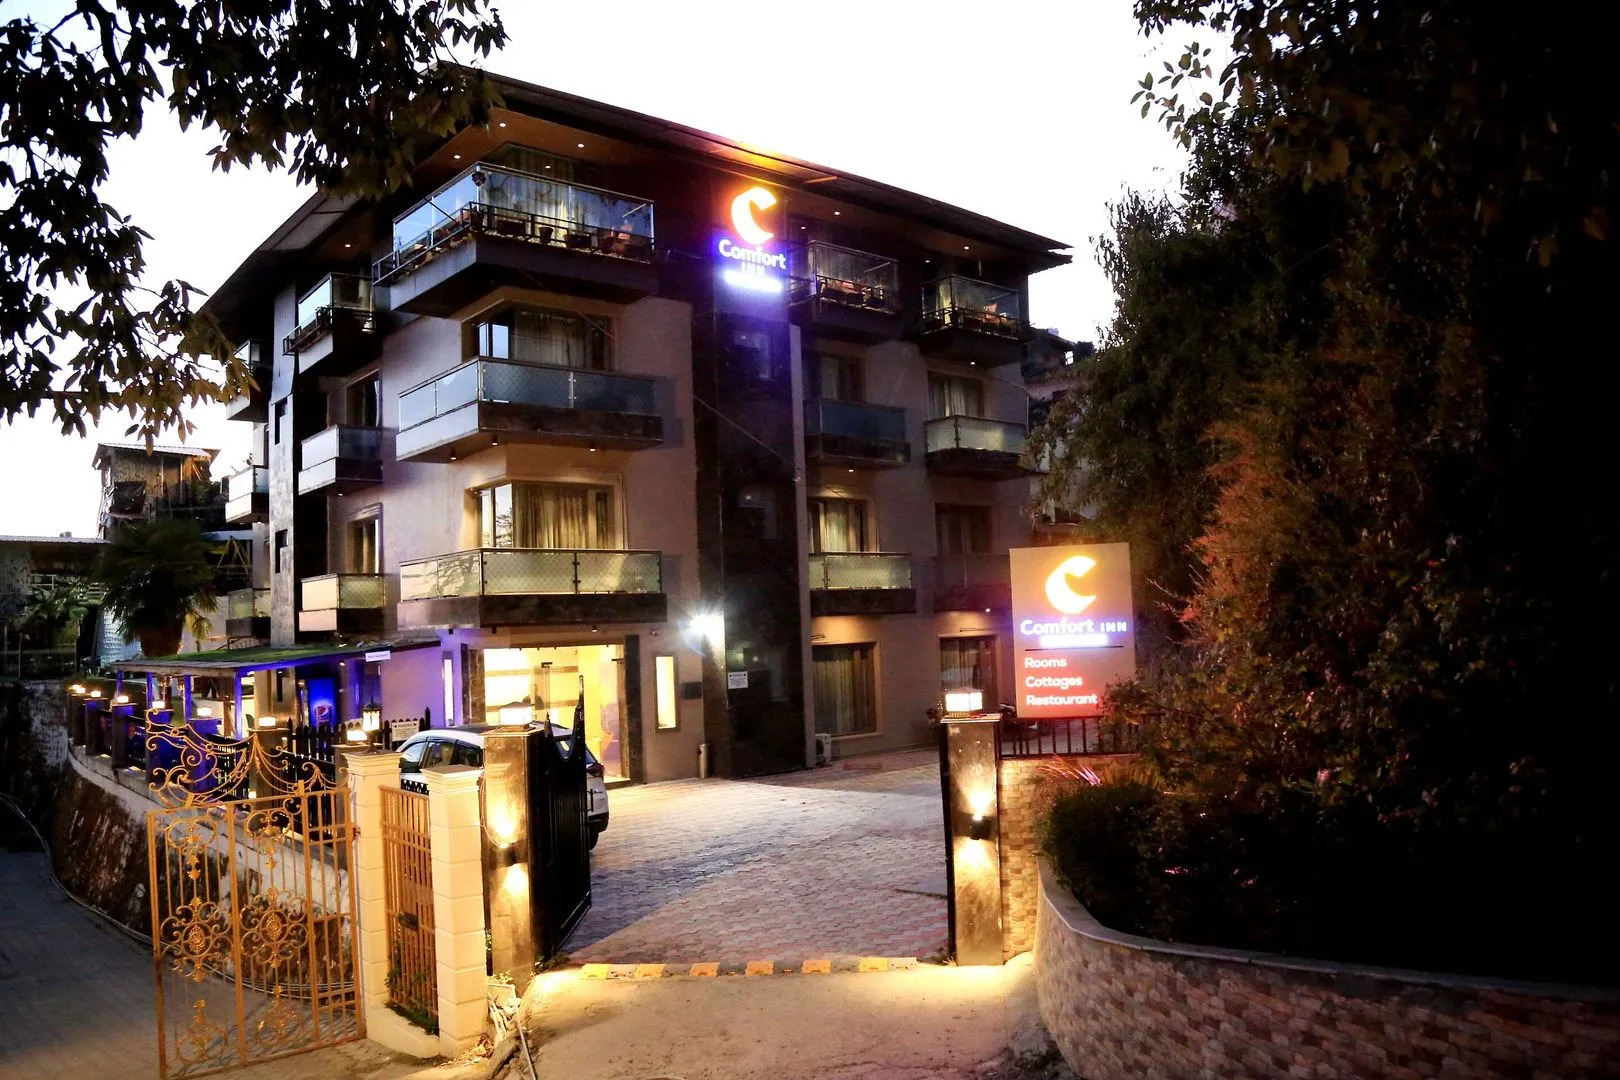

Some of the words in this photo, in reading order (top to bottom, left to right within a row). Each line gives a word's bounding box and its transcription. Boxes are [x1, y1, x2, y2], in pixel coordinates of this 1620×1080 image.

[718, 238, 786, 270] Comfort
[1020, 617, 1095, 635] Comfort
[1100, 621, 1127, 632] INN
[1025, 657, 1068, 669] Rooms
[1025, 675, 1083, 690] Cottages
[1026, 693, 1098, 706] Restaurant
